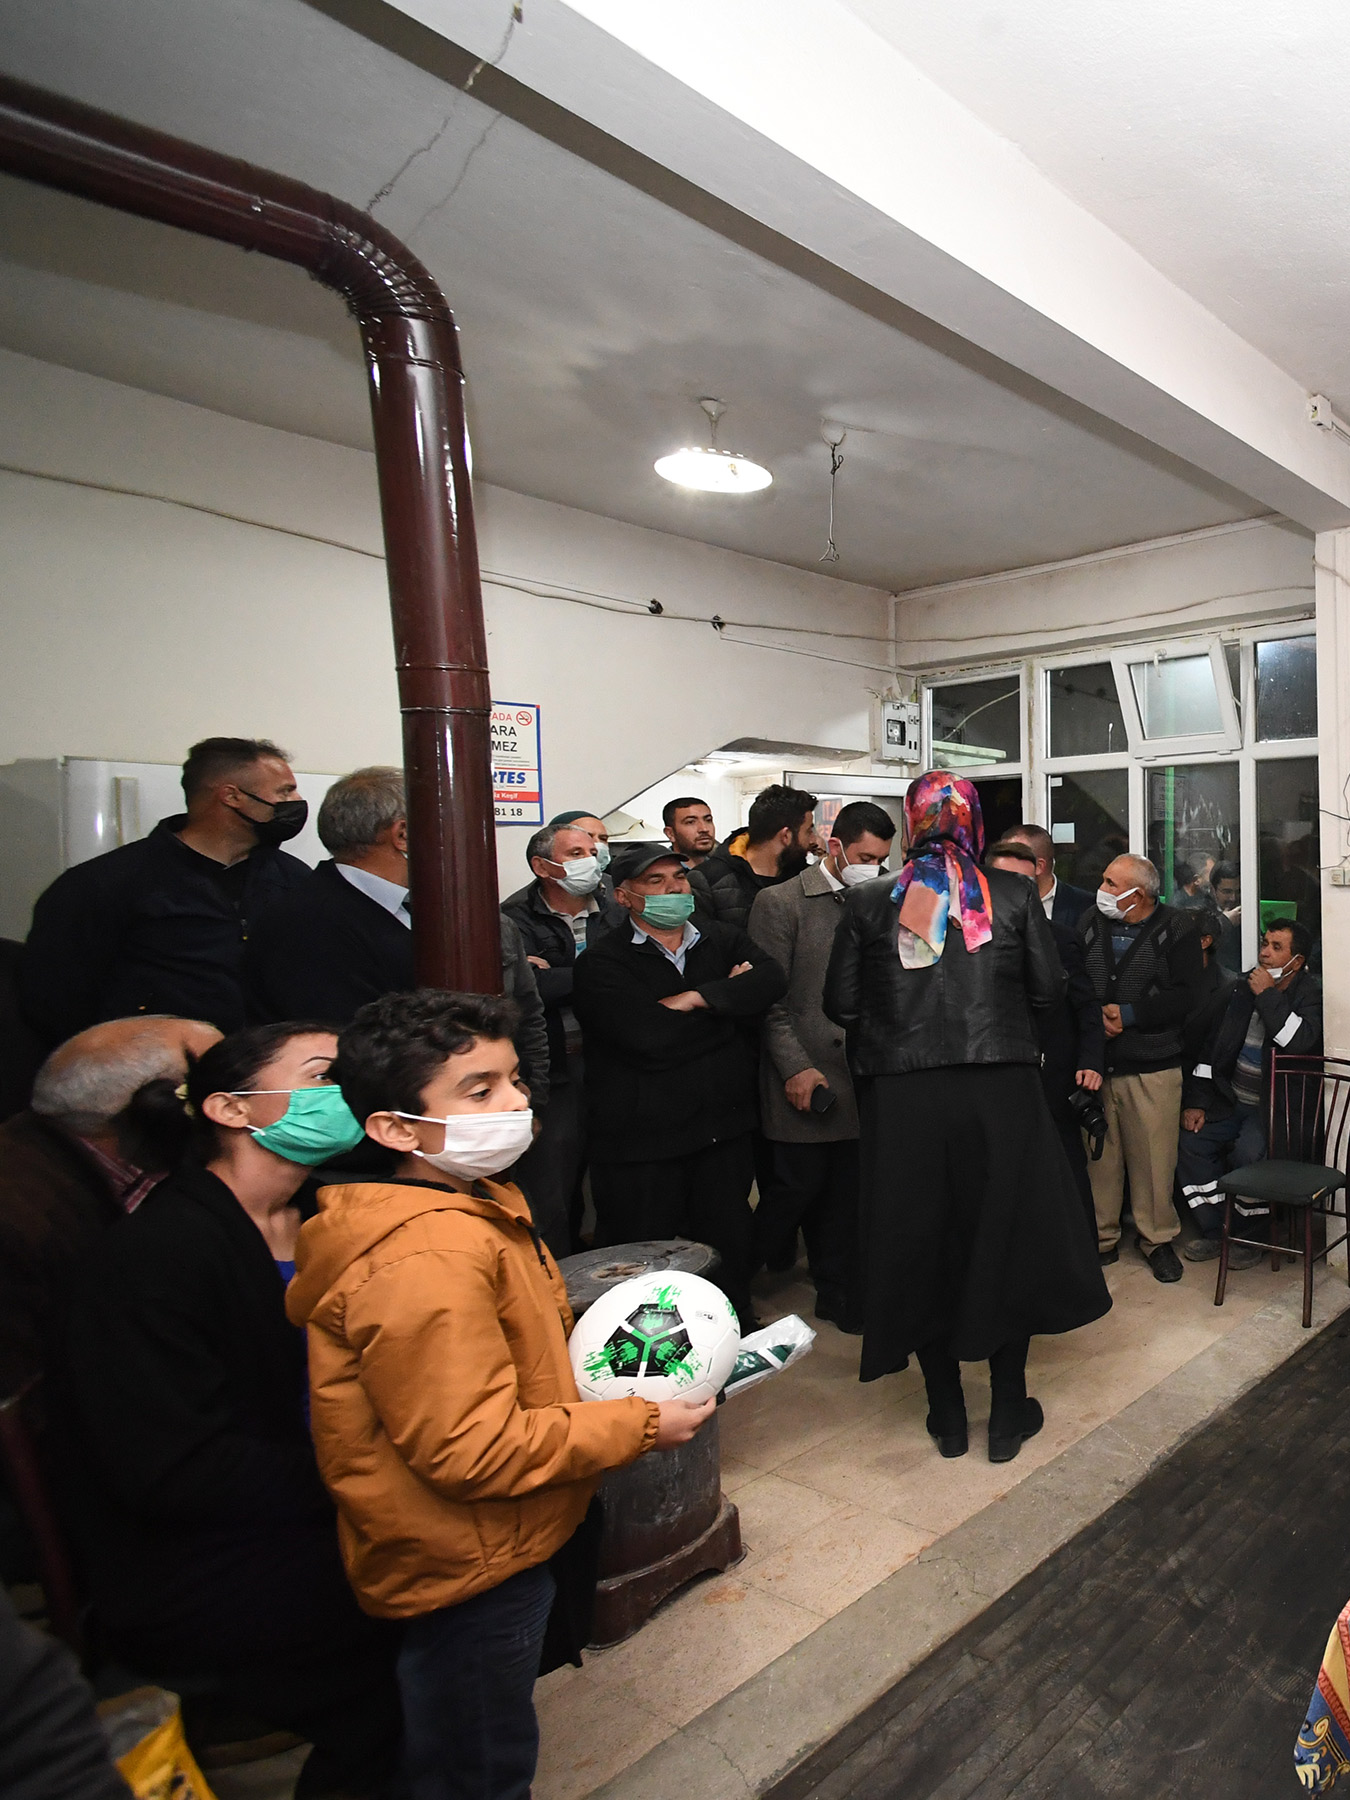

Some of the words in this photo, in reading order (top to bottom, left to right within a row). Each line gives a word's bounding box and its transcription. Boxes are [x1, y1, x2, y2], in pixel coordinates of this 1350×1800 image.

[491, 712, 513, 721] ADA
[491, 725, 518, 737] ARA
[491, 740, 518, 752] MEZ
[510, 807, 523, 817] 18
